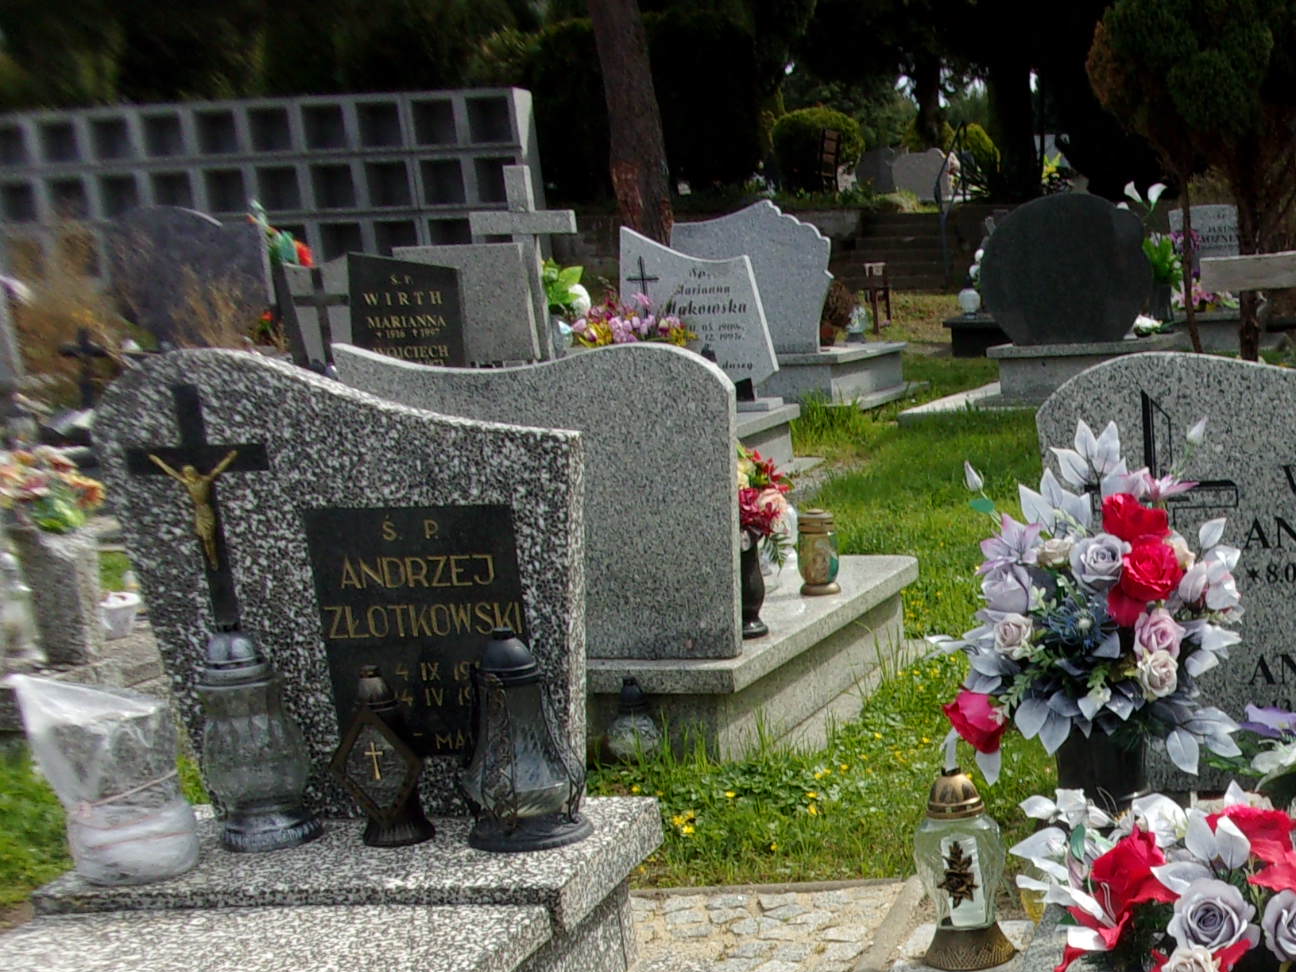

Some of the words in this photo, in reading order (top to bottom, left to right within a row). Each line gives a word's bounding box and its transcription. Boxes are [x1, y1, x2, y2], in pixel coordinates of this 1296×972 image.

[362, 290, 444, 306] WIRTH
[366, 313, 448, 329] MARIANNA
[340, 553, 496, 590] ANDRZEJ
[322, 600, 524, 640] ZŁOTKOWSKI
[420, 662, 441, 681] IX
[424, 687, 444, 707] IV
